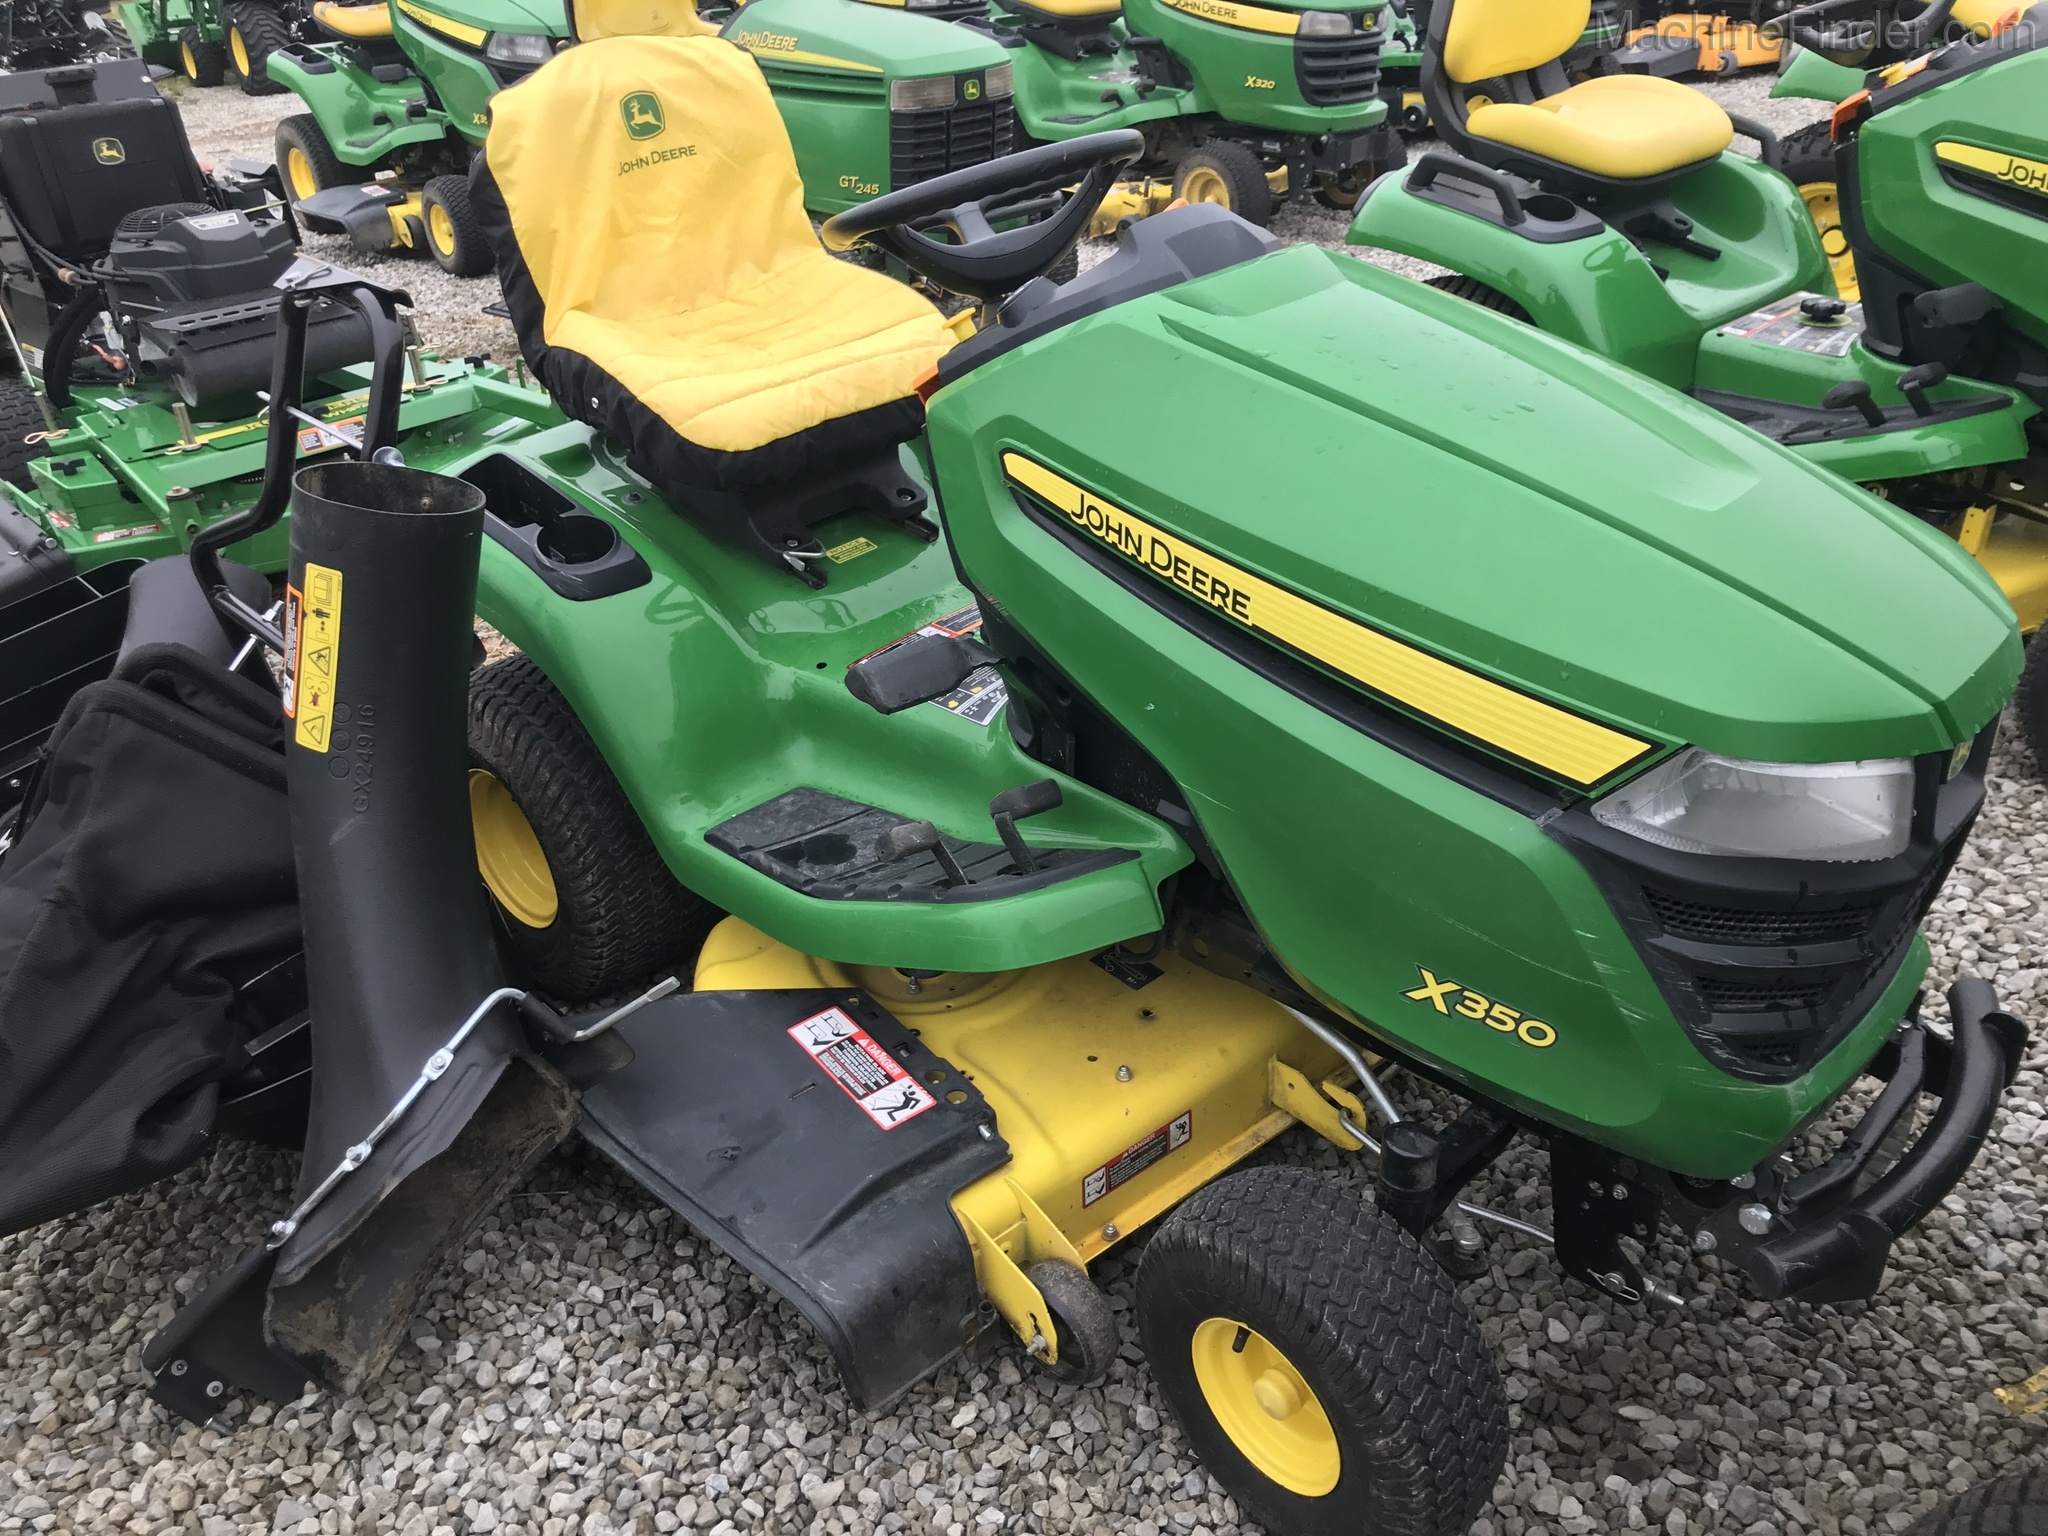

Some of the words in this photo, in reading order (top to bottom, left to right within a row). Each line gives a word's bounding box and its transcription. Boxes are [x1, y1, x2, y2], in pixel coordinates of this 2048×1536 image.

[1202, 1, 1238, 19] DEERE
[733, 29, 761, 49] JOHN
[759, 31, 798, 51] DEERE
[1244, 75, 1276, 90] X320
[618, 156, 650, 177] JOHN
[650, 145, 698, 165] DEERE
[1997, 158, 2048, 189] JOH
[1071, 493, 1142, 560] JOHN
[1149, 536, 1252, 622] DEERE
[353, 702, 376, 815] GX24916
[1404, 967, 1557, 1048] X350
[866, 1043, 902, 1077] DANGER
[1128, 1133, 1156, 1155] DANGER
